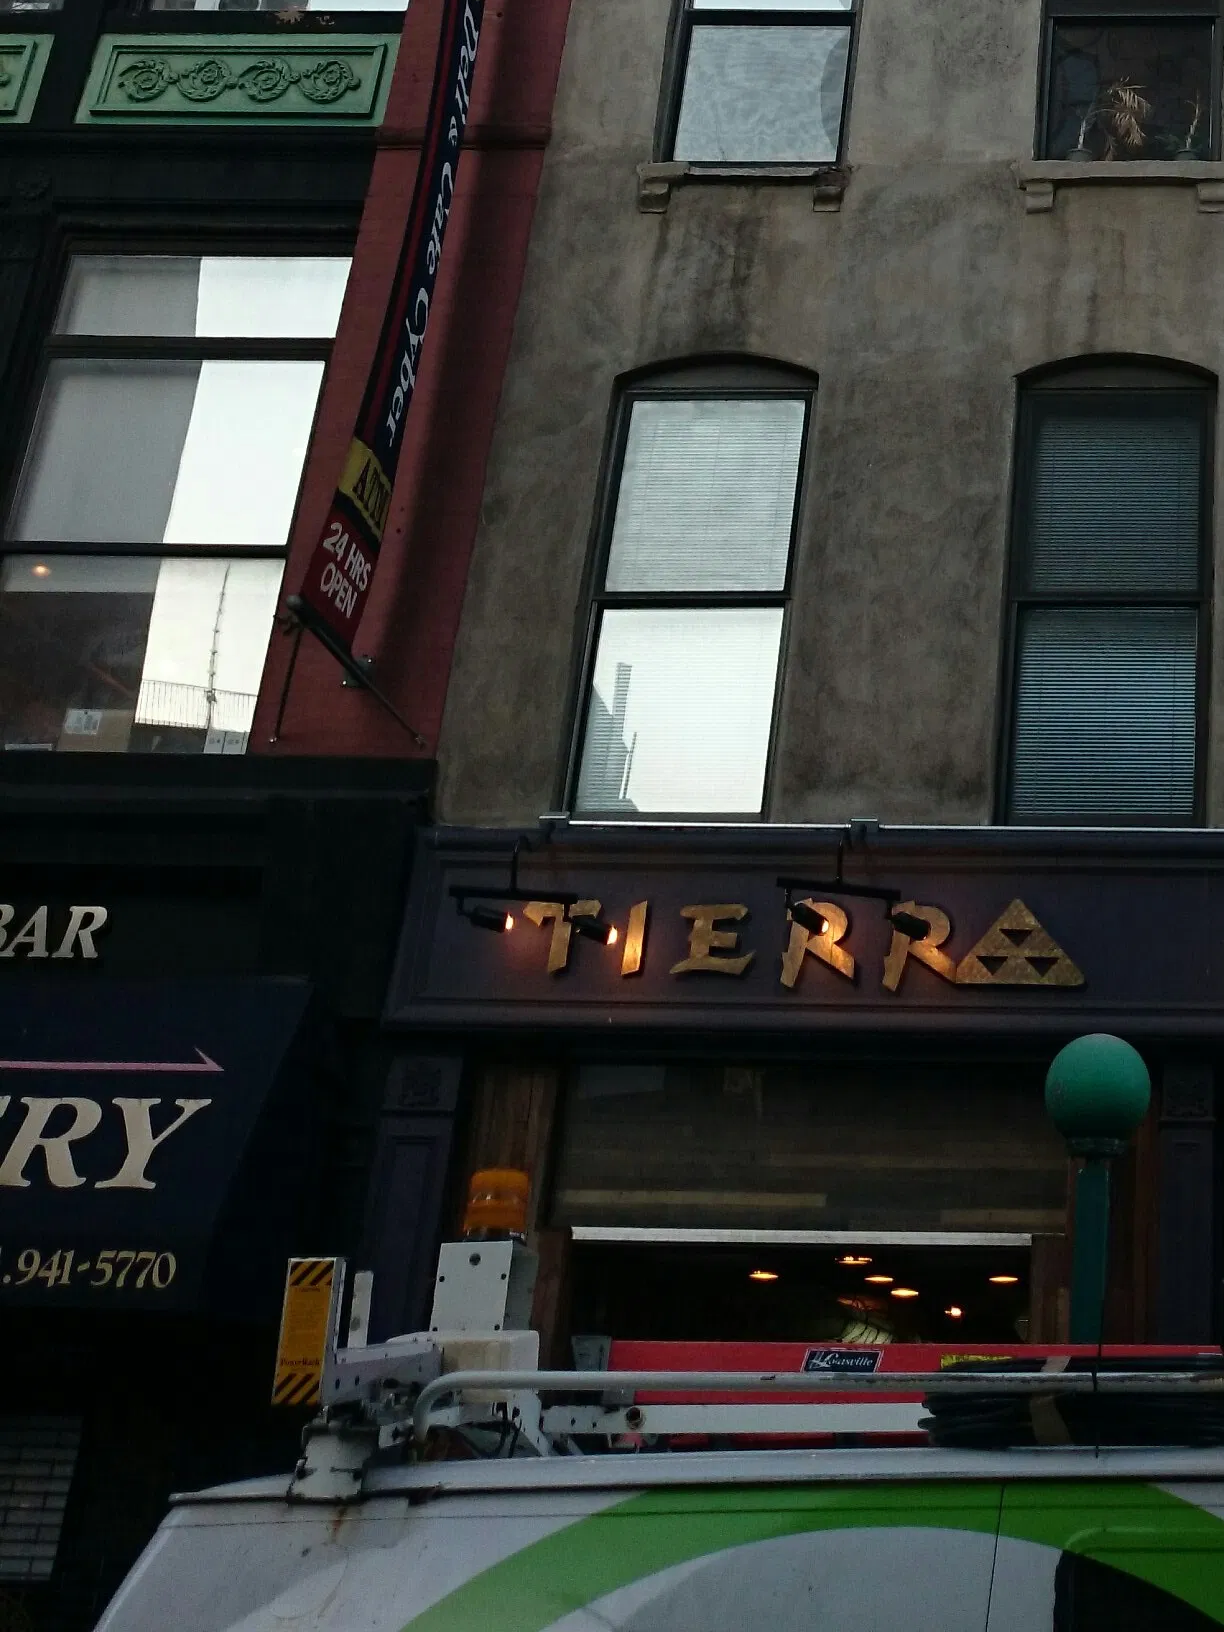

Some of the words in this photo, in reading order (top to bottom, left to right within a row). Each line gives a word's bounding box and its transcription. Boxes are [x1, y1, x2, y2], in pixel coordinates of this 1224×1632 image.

[385, 287, 430, 448] Cyber
[319, 561, 359, 620] OPEN
[322, 521, 349, 562] 24
[343, 542, 372, 592] HRS
[522, 896, 1086, 992] TIERRA
[0, 1094, 213, 1190] RY
[0, 1246, 178, 1289] .941-5770
